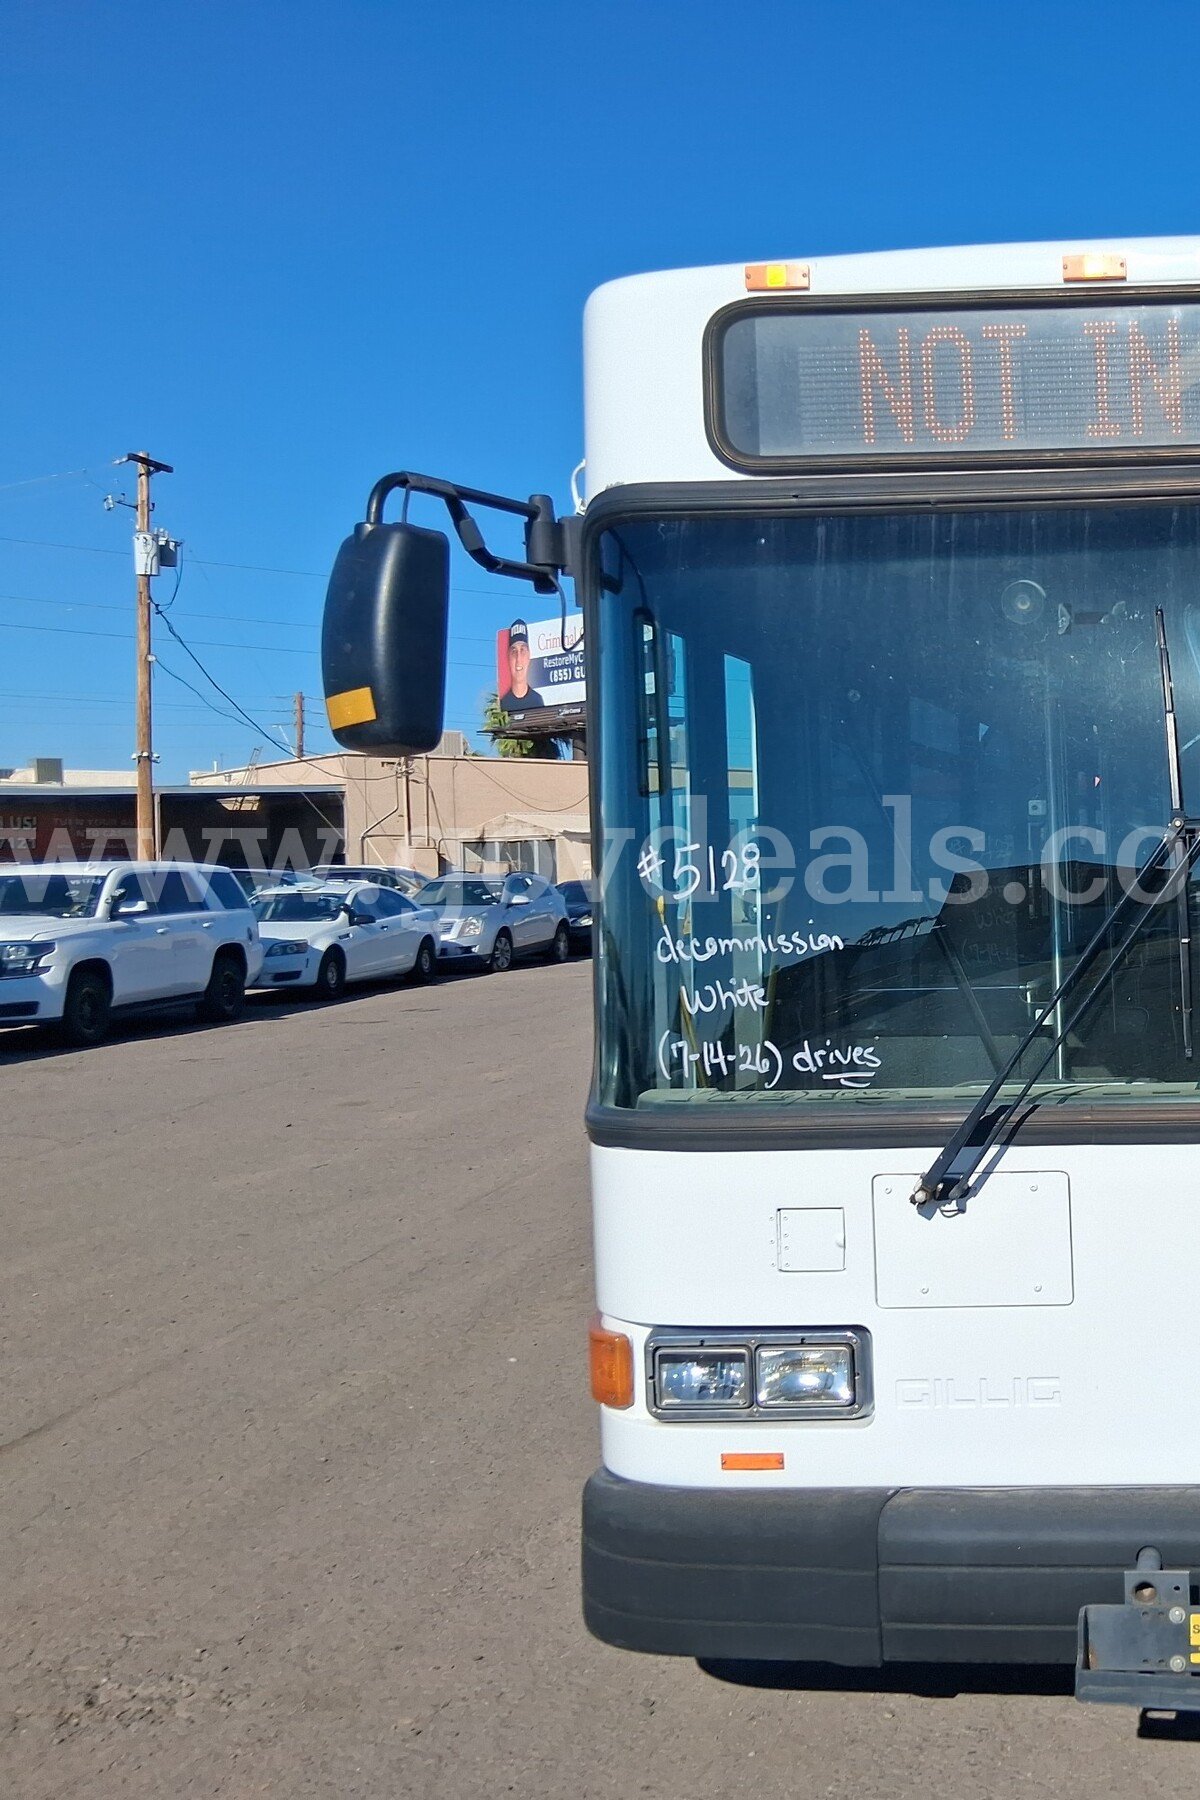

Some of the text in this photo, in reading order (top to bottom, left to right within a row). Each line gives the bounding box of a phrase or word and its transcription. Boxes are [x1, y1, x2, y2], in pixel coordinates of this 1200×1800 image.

[859, 323, 1026, 443] NOT
[1083, 318, 1182, 437] IN
[538, 626, 577, 651] Crimnal
[549, 668, 572, 683] (855)
[637, 842, 760, 900] #5128
[656, 915, 844, 963] decommission
[680, 977, 770, 1015] White
[658, 1029, 882, 1088] (7-14-26) drives
[895, 1376, 1062, 1409] GILLIG
